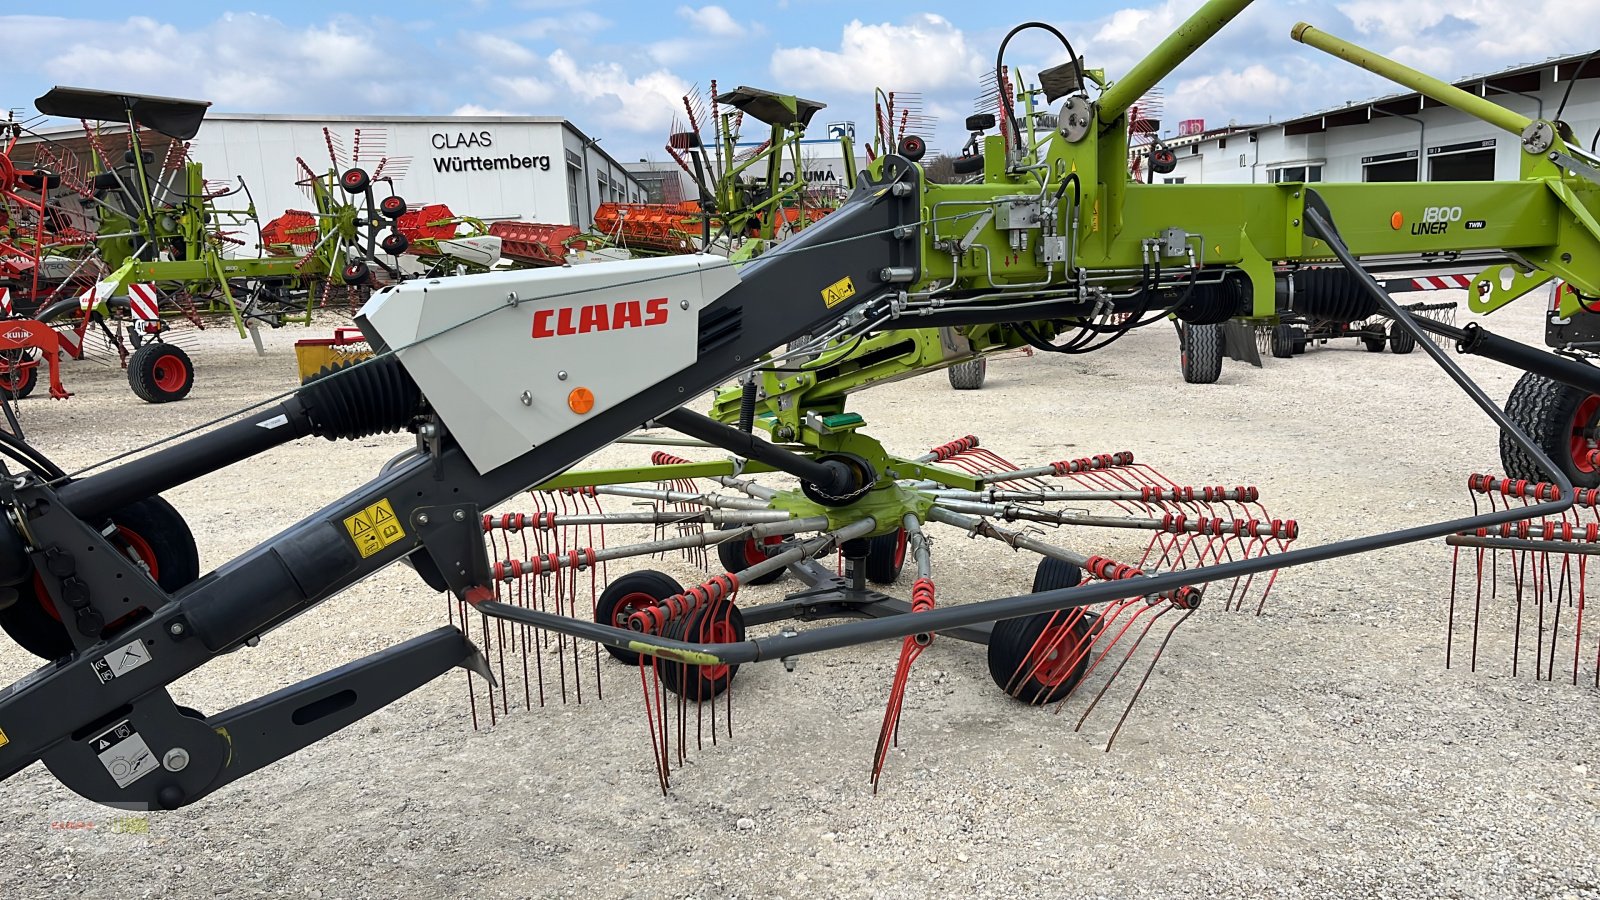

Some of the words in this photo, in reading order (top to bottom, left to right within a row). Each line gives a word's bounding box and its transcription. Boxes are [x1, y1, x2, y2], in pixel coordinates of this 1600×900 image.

[431, 131, 493, 149] CLAAS
[432, 153, 551, 173] Württemberg
[783, 170, 836, 184] OUMA
[1422, 206, 1462, 223] 1800
[1411, 221, 1448, 236] LINER
[531, 297, 669, 339] CLAAS
